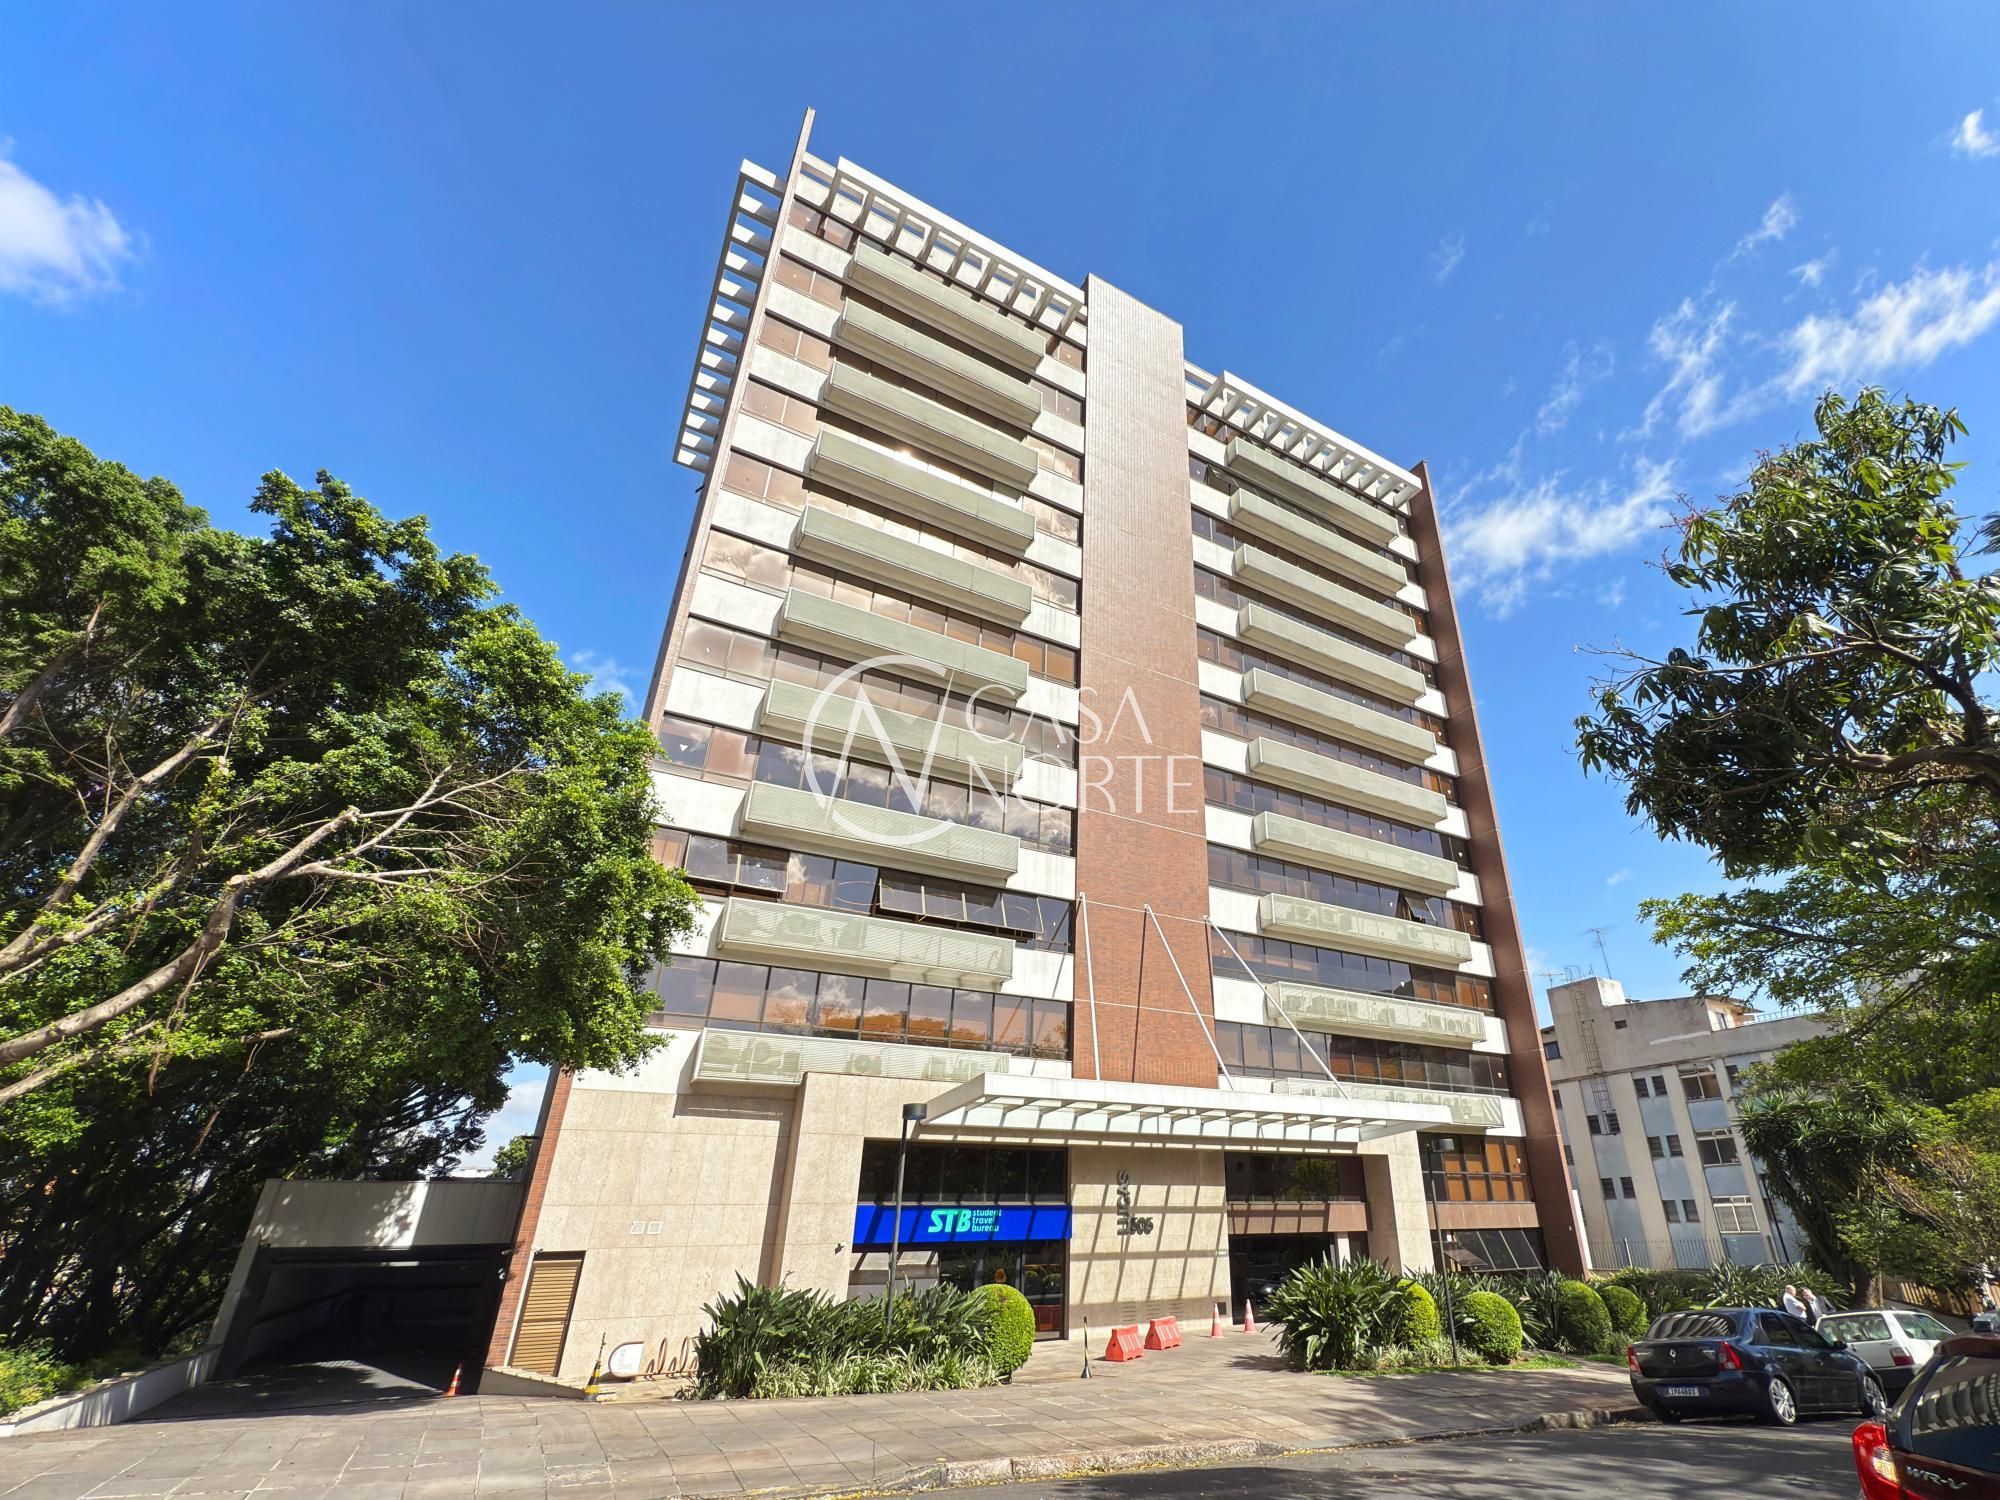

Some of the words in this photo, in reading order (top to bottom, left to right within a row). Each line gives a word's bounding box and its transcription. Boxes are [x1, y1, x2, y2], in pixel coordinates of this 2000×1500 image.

[972, 1208, 1002, 1217] student
[928, 1209, 972, 1232] STB
[972, 1216, 996, 1224] travel
[971, 1224, 1000, 1232] bureau
[1906, 1465, 1968, 1489] WR-V
